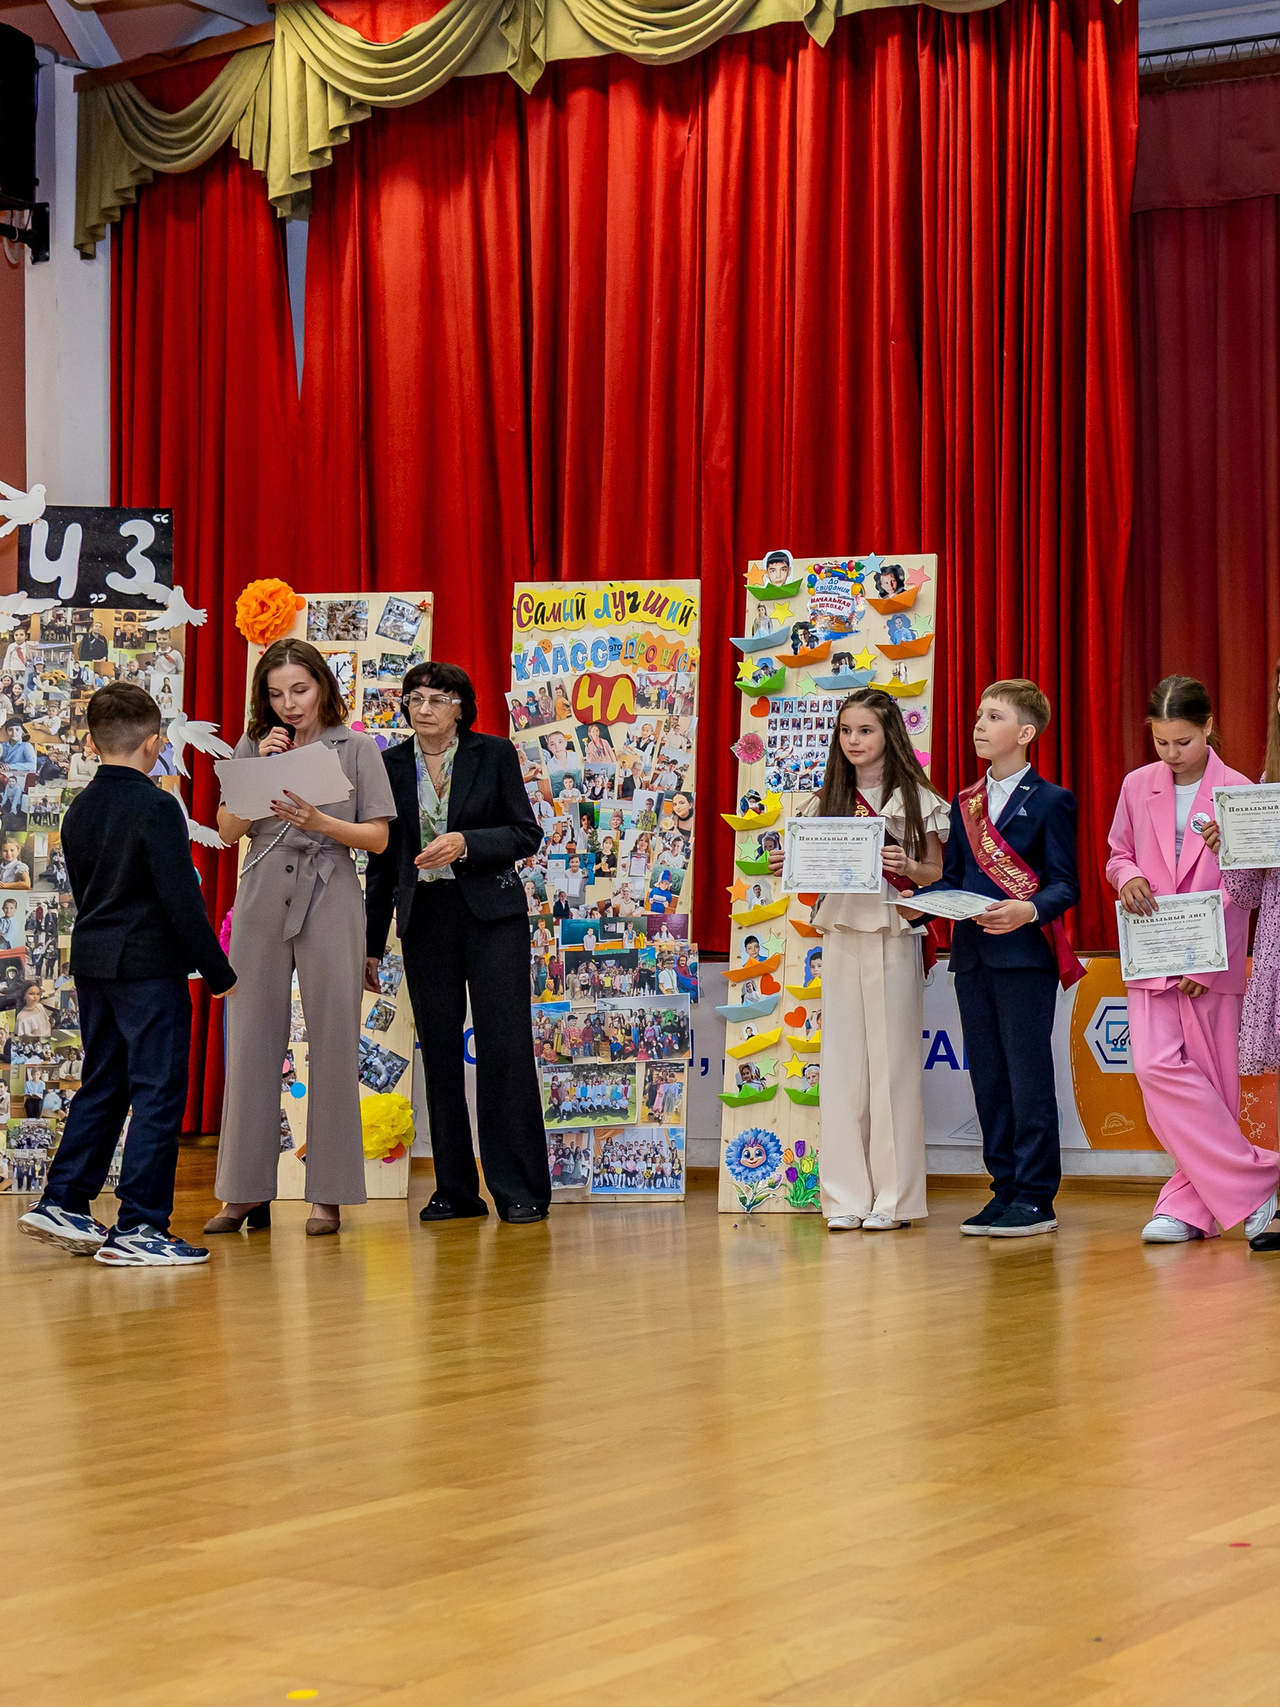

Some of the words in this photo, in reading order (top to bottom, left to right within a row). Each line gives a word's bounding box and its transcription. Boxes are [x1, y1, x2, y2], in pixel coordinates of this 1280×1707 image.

[516, 592, 587, 628] Самый
[514, 636, 608, 681] КЛАСС
[624, 638, 657, 665] ПРО
